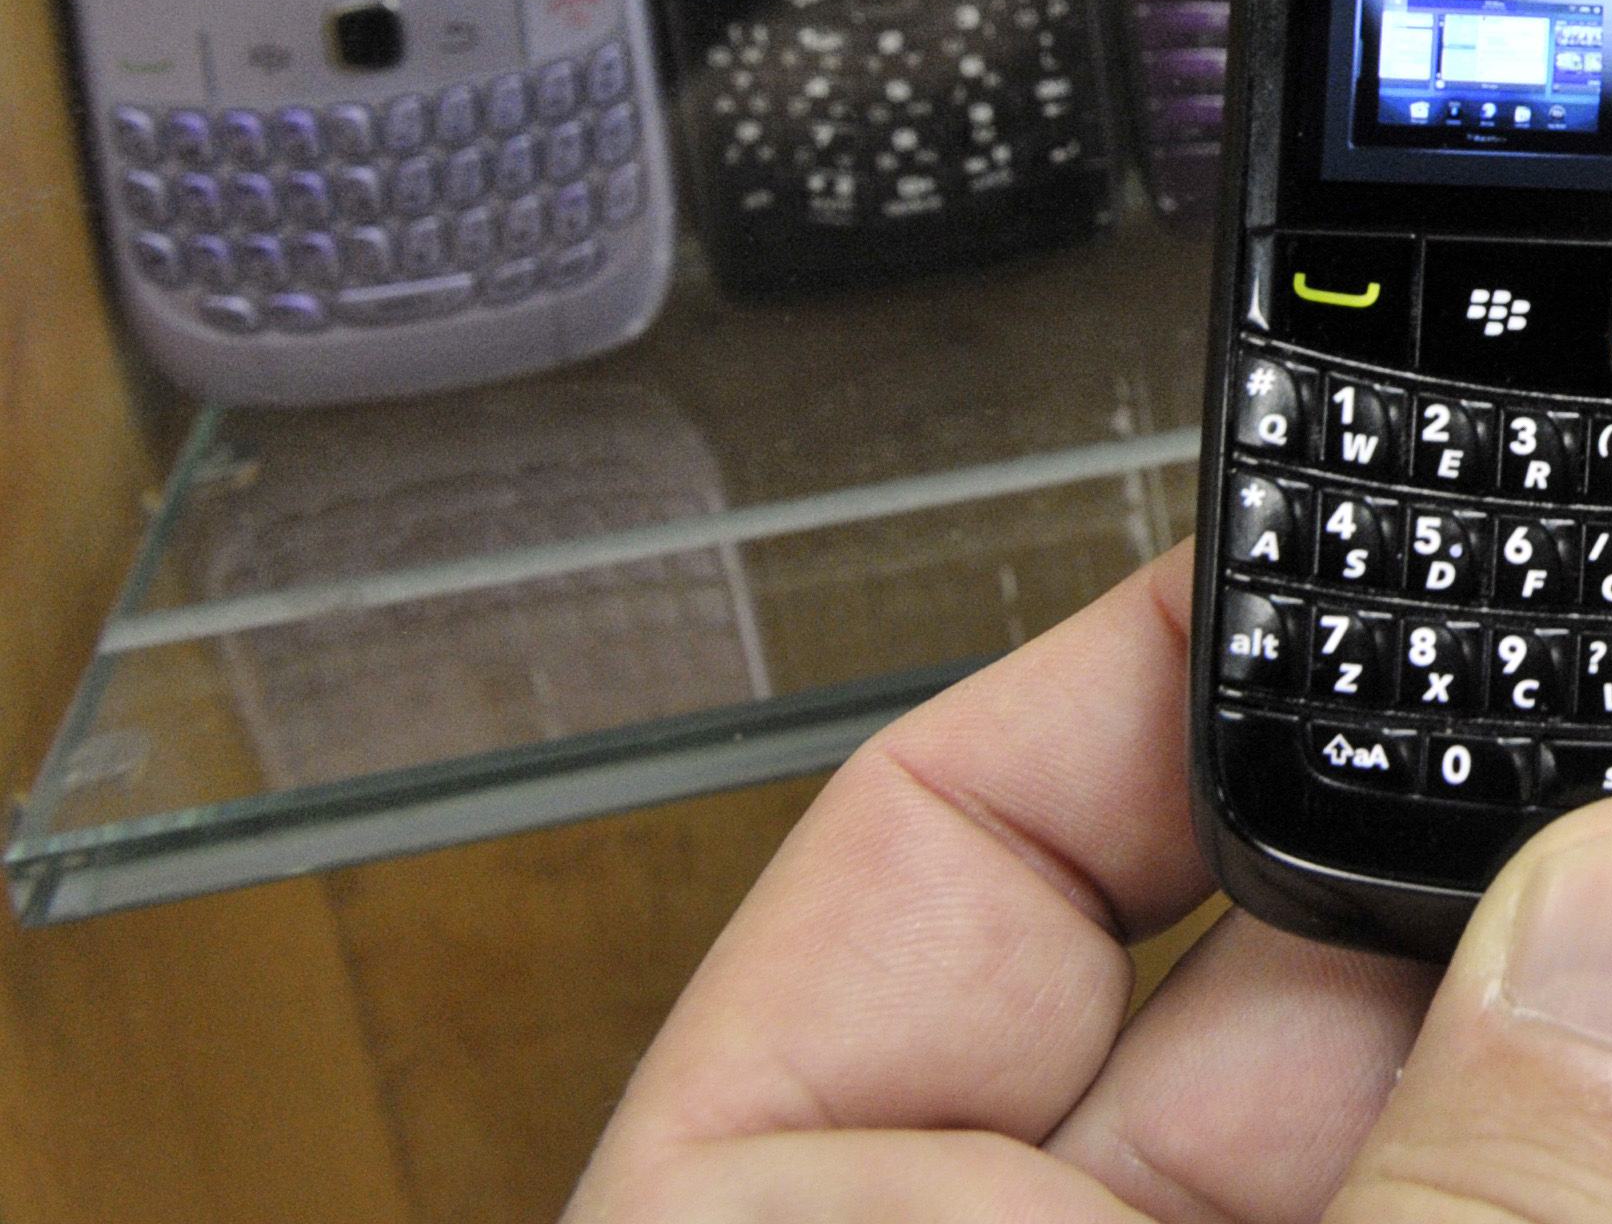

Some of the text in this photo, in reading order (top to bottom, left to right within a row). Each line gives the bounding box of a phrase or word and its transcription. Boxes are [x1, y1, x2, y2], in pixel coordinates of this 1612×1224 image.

[1246, 369, 1274, 395] #
[1333, 387, 1355, 424] 1
[1422, 404, 1450, 442] 2
[1509, 417, 1537, 456] 3
[1259, 414, 1287, 445] Q
[1342, 433, 1378, 464] W
[1438, 450, 1464, 478] E
[1524, 461, 1550, 489] R
[1250, 531, 1279, 562] A
[1343, 550, 1369, 578] S
[1426, 562, 1456, 590] D
[1521, 570, 1547, 598] F
[1326, 502, 1356, 540] 4
[1414, 517, 1441, 554] 5
[1504, 527, 1532, 565] 6
[1230, 629, 1279, 660] alt
[1334, 663, 1362, 693] Z
[1422, 674, 1454, 702] X
[1512, 680, 1539, 708] C
[1320, 616, 1350, 654] 7
[1409, 628, 1437, 667] 8
[1499, 636, 1527, 674] 9
[1588, 642, 1607, 674] ?
